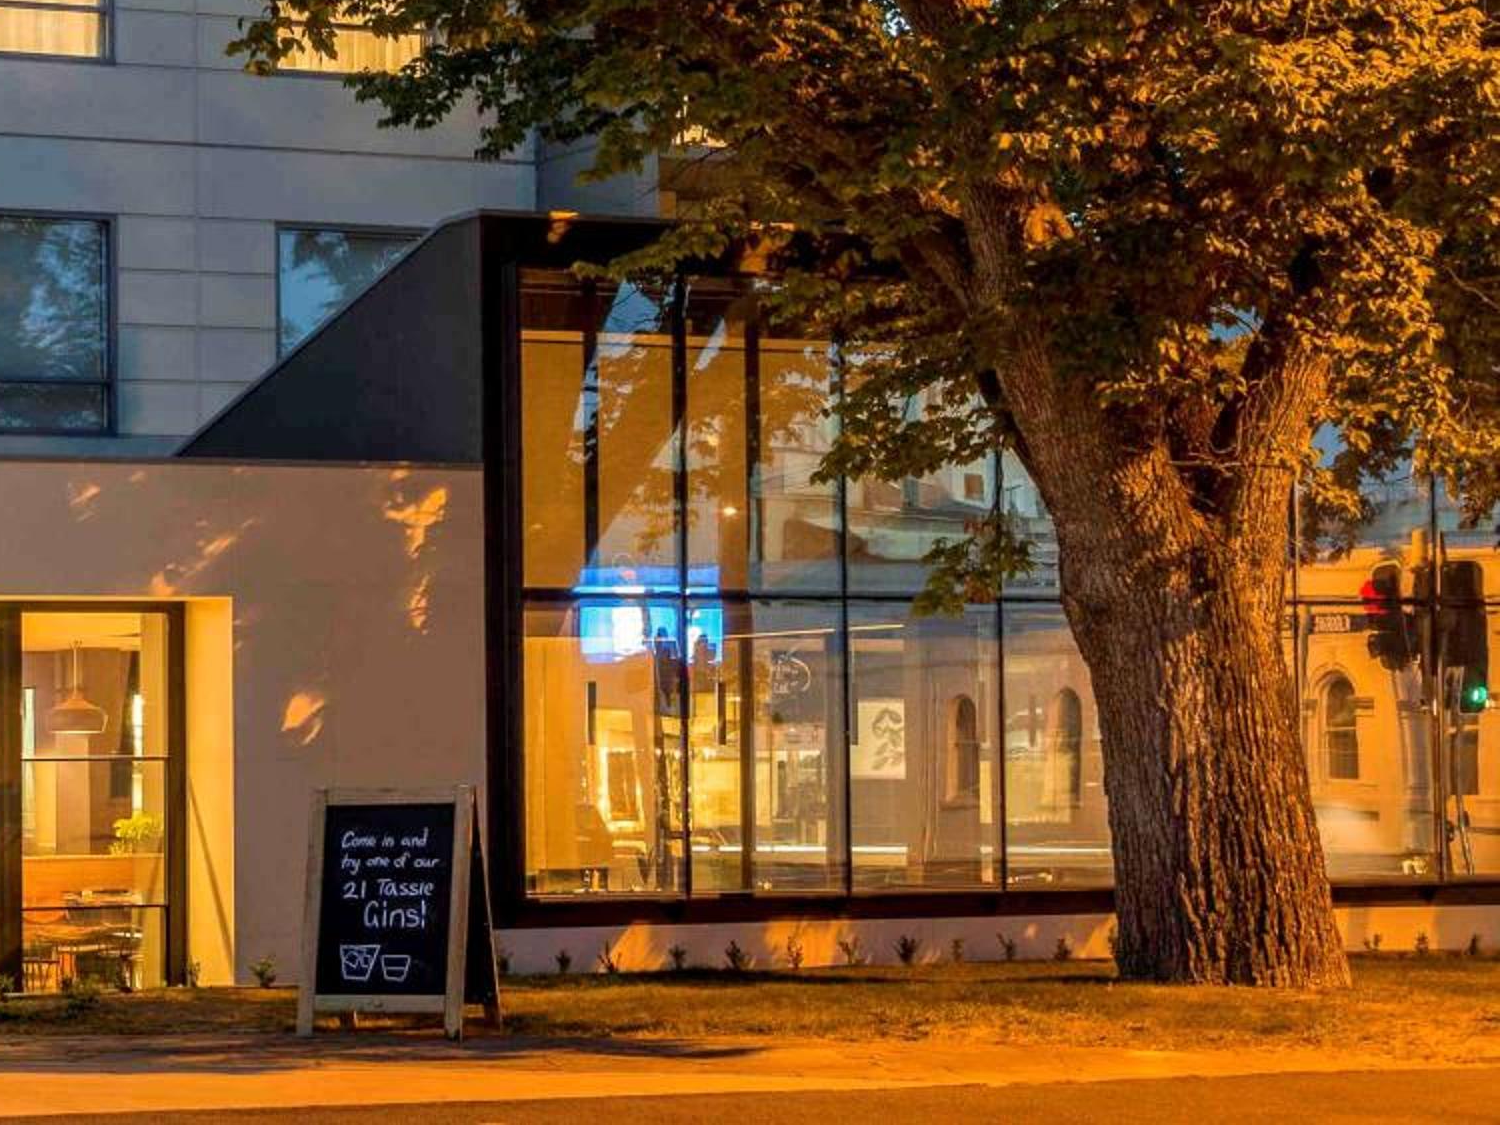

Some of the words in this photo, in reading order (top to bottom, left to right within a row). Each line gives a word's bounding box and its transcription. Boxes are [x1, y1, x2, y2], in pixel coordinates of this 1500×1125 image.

[341, 830, 376, 848] Come
[381, 833, 395, 848] in
[400, 826, 429, 847] and
[341, 853, 361, 875] try
[365, 856, 391, 868] one
[393, 851, 411, 868] of
[413, 858, 440, 868] our
[343, 880, 367, 899] 21
[377, 877, 435, 896] Tassie
[363, 900, 426, 929] Gins!
